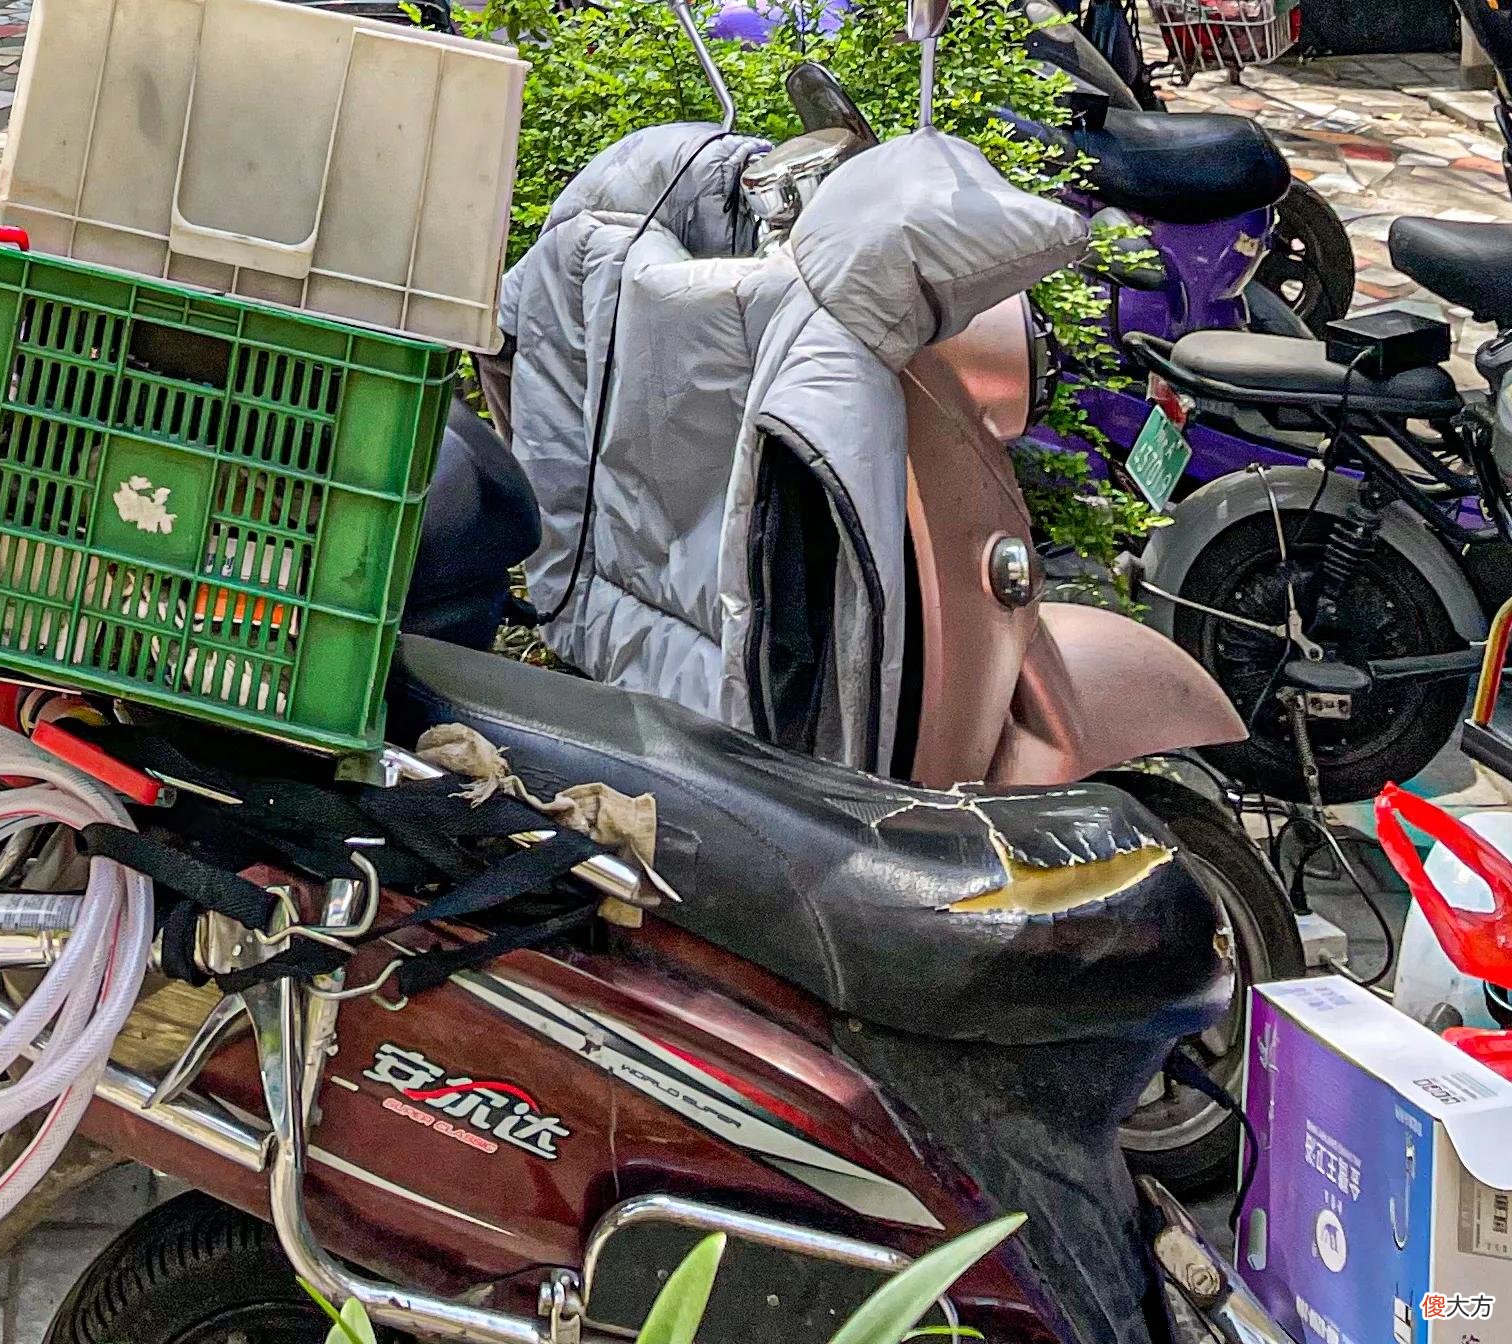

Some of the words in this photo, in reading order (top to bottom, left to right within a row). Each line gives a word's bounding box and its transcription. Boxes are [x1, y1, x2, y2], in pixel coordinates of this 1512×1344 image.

[382, 1097, 435, 1127] SUPER
[433, 1120, 500, 1154] CLASSIC
[621, 1064, 680, 1098] WORLD
[682, 1095, 741, 1128] SUPER
